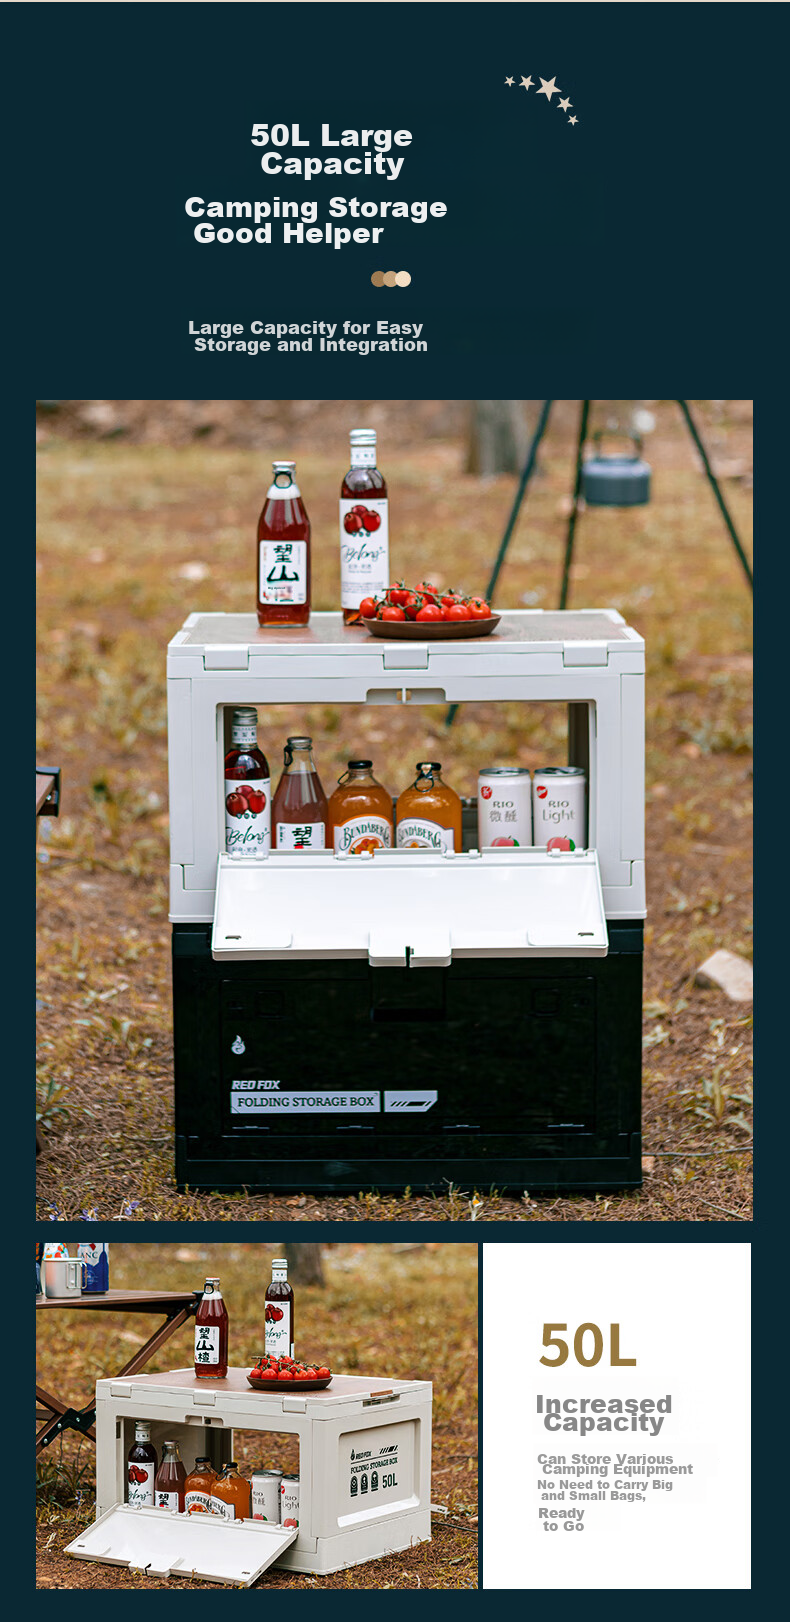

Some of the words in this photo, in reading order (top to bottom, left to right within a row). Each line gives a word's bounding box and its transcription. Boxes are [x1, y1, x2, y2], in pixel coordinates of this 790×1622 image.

[493, 800, 514, 808] RIO
[548, 800, 570, 808] RIO
[542, 808, 575, 824] Light
[292, 827, 312, 847] 望
[232, 1080, 256, 1090] RED
[257, 1080, 280, 1090] FOX
[237, 1097, 290, 1107] FOLDING
[292, 1096, 347, 1107] STORAGE
[349, 1096, 374, 1107] BOX
[382, 1472, 398, 1488] 50L
